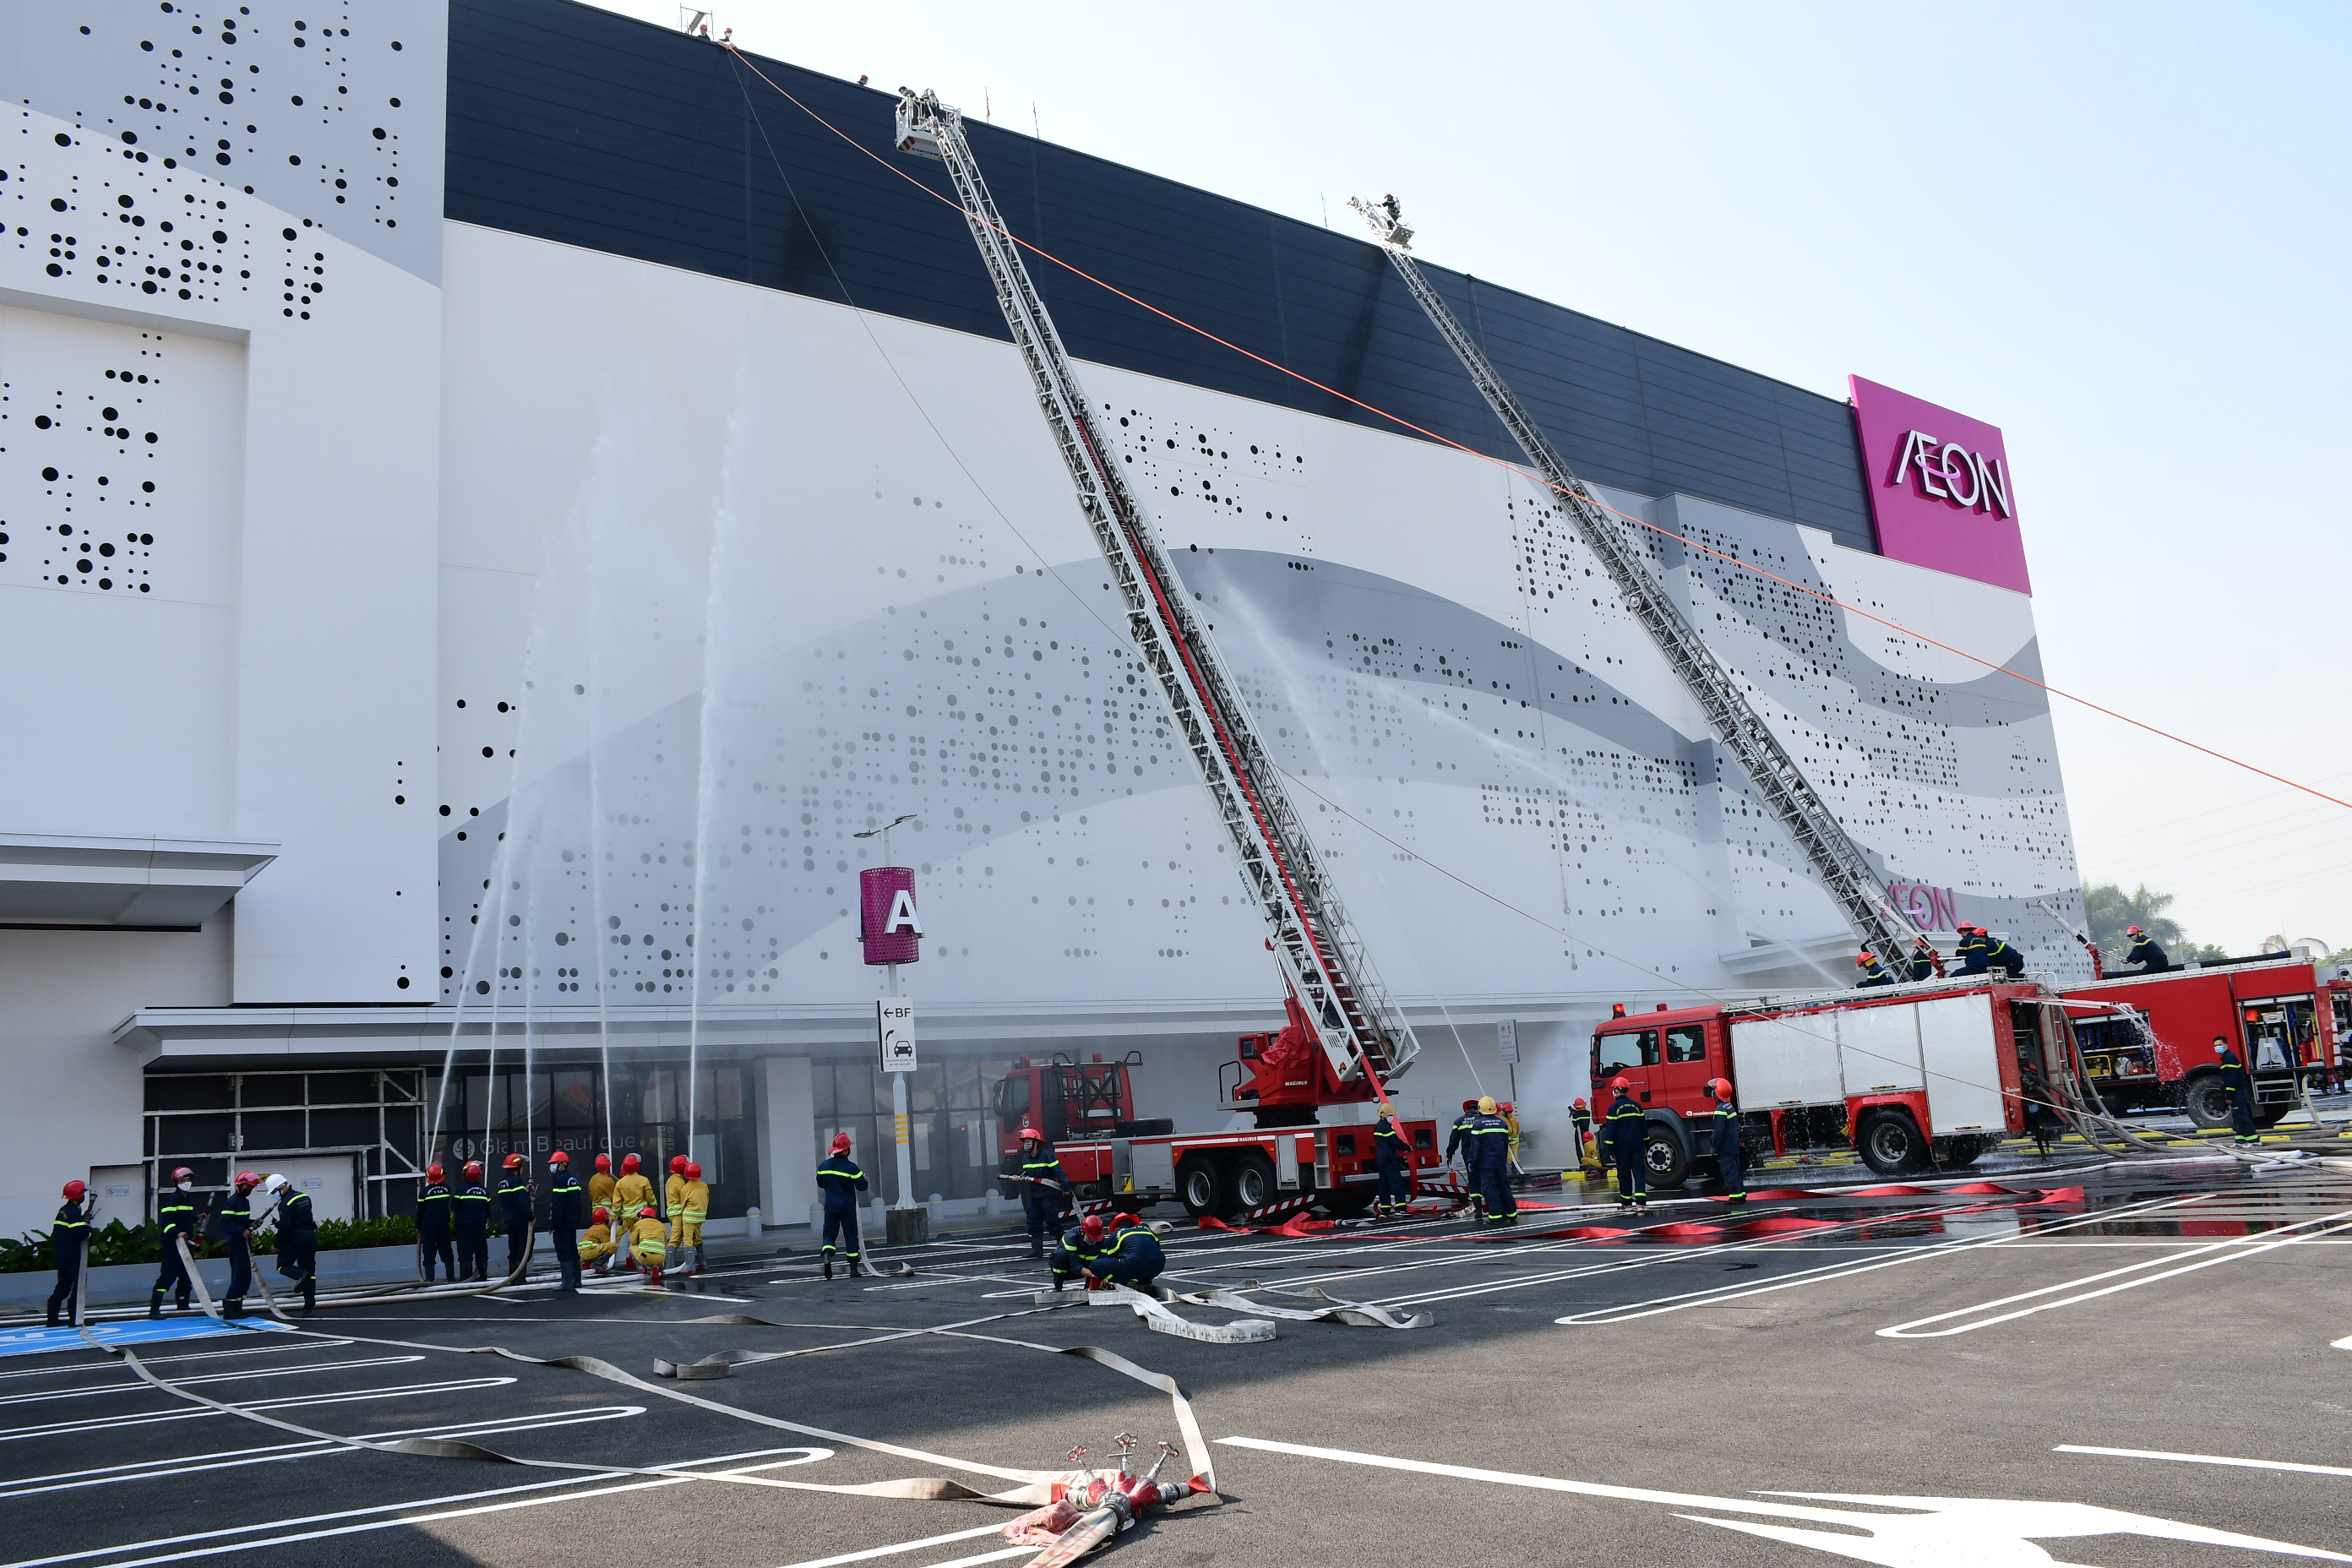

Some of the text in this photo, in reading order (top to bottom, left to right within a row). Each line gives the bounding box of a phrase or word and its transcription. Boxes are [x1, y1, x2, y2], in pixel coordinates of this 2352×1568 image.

[1239, 869, 1256, 906] MAGIRUS
[884, 890, 924, 934] A
[896, 1007, 912, 1018] BF
[479, 1135, 635, 1155] Glam Beautque
